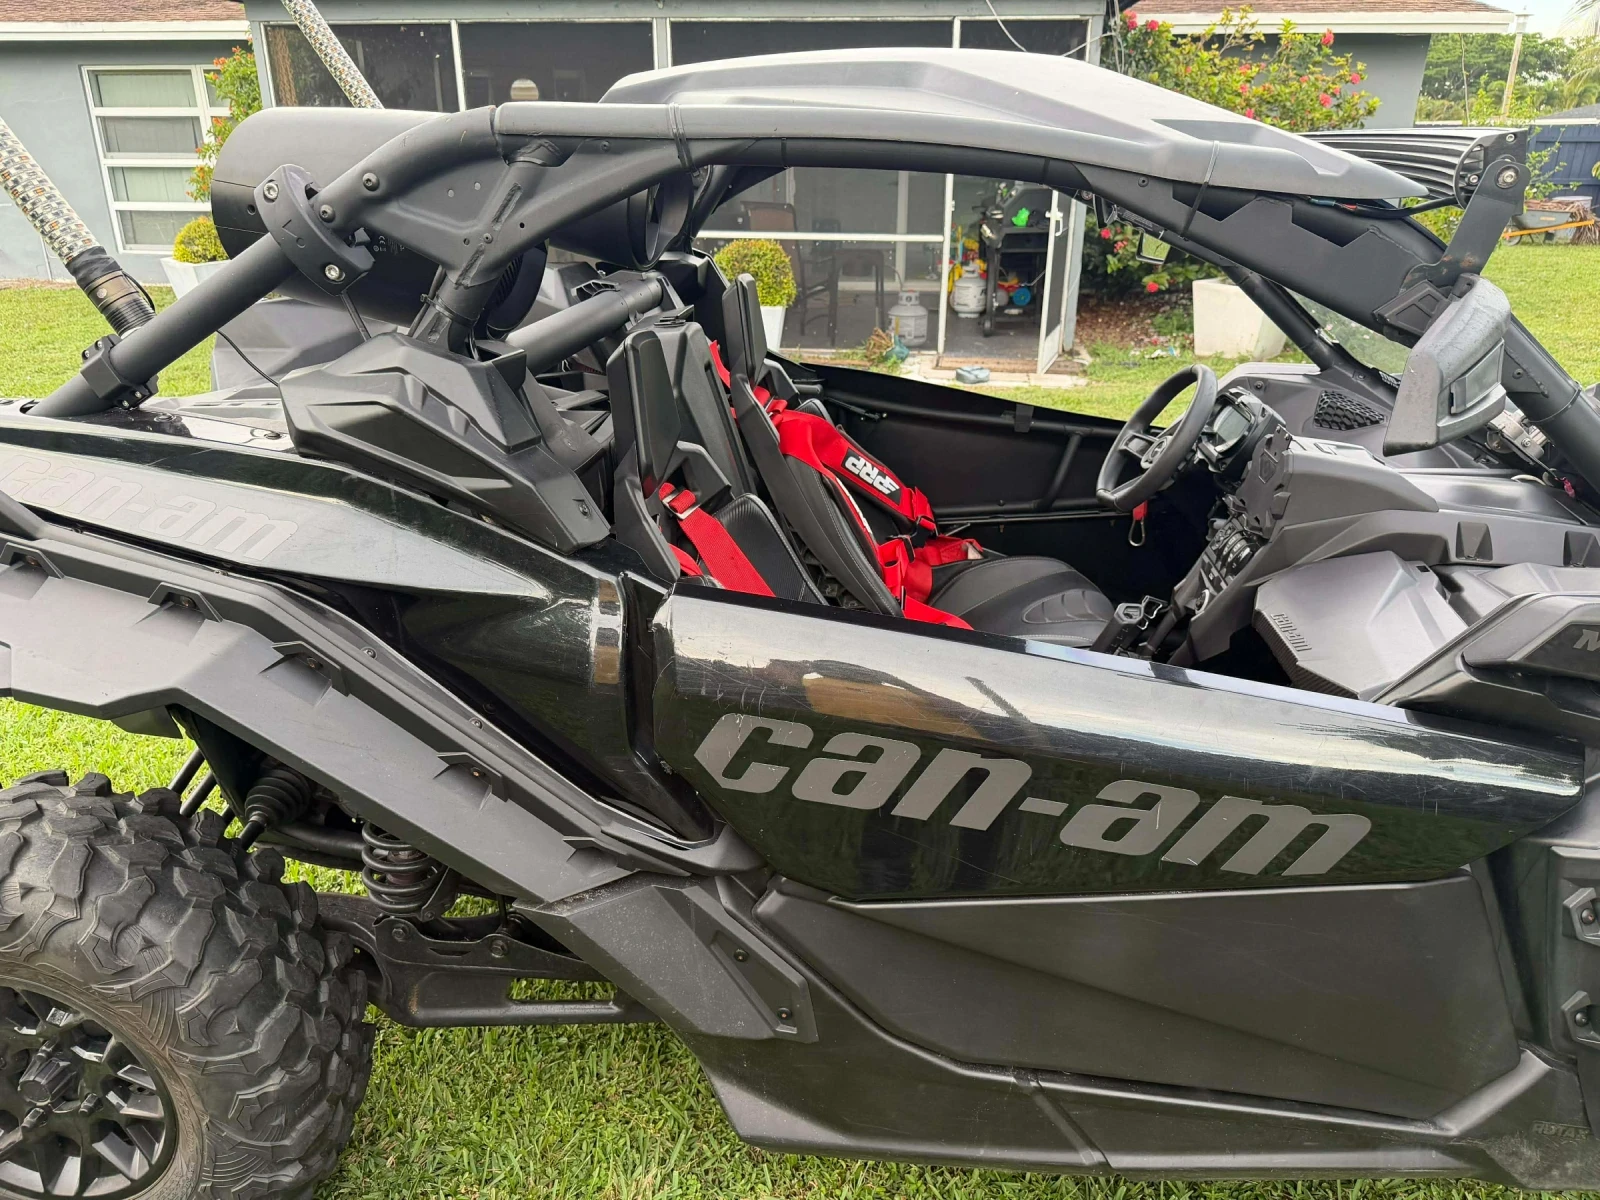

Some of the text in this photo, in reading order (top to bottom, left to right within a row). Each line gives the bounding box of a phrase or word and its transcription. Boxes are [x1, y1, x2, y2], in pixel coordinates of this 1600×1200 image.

[0, 454, 299, 561] can-am
[845, 456, 900, 494] PRP
[694, 713, 1372, 876] can-am
